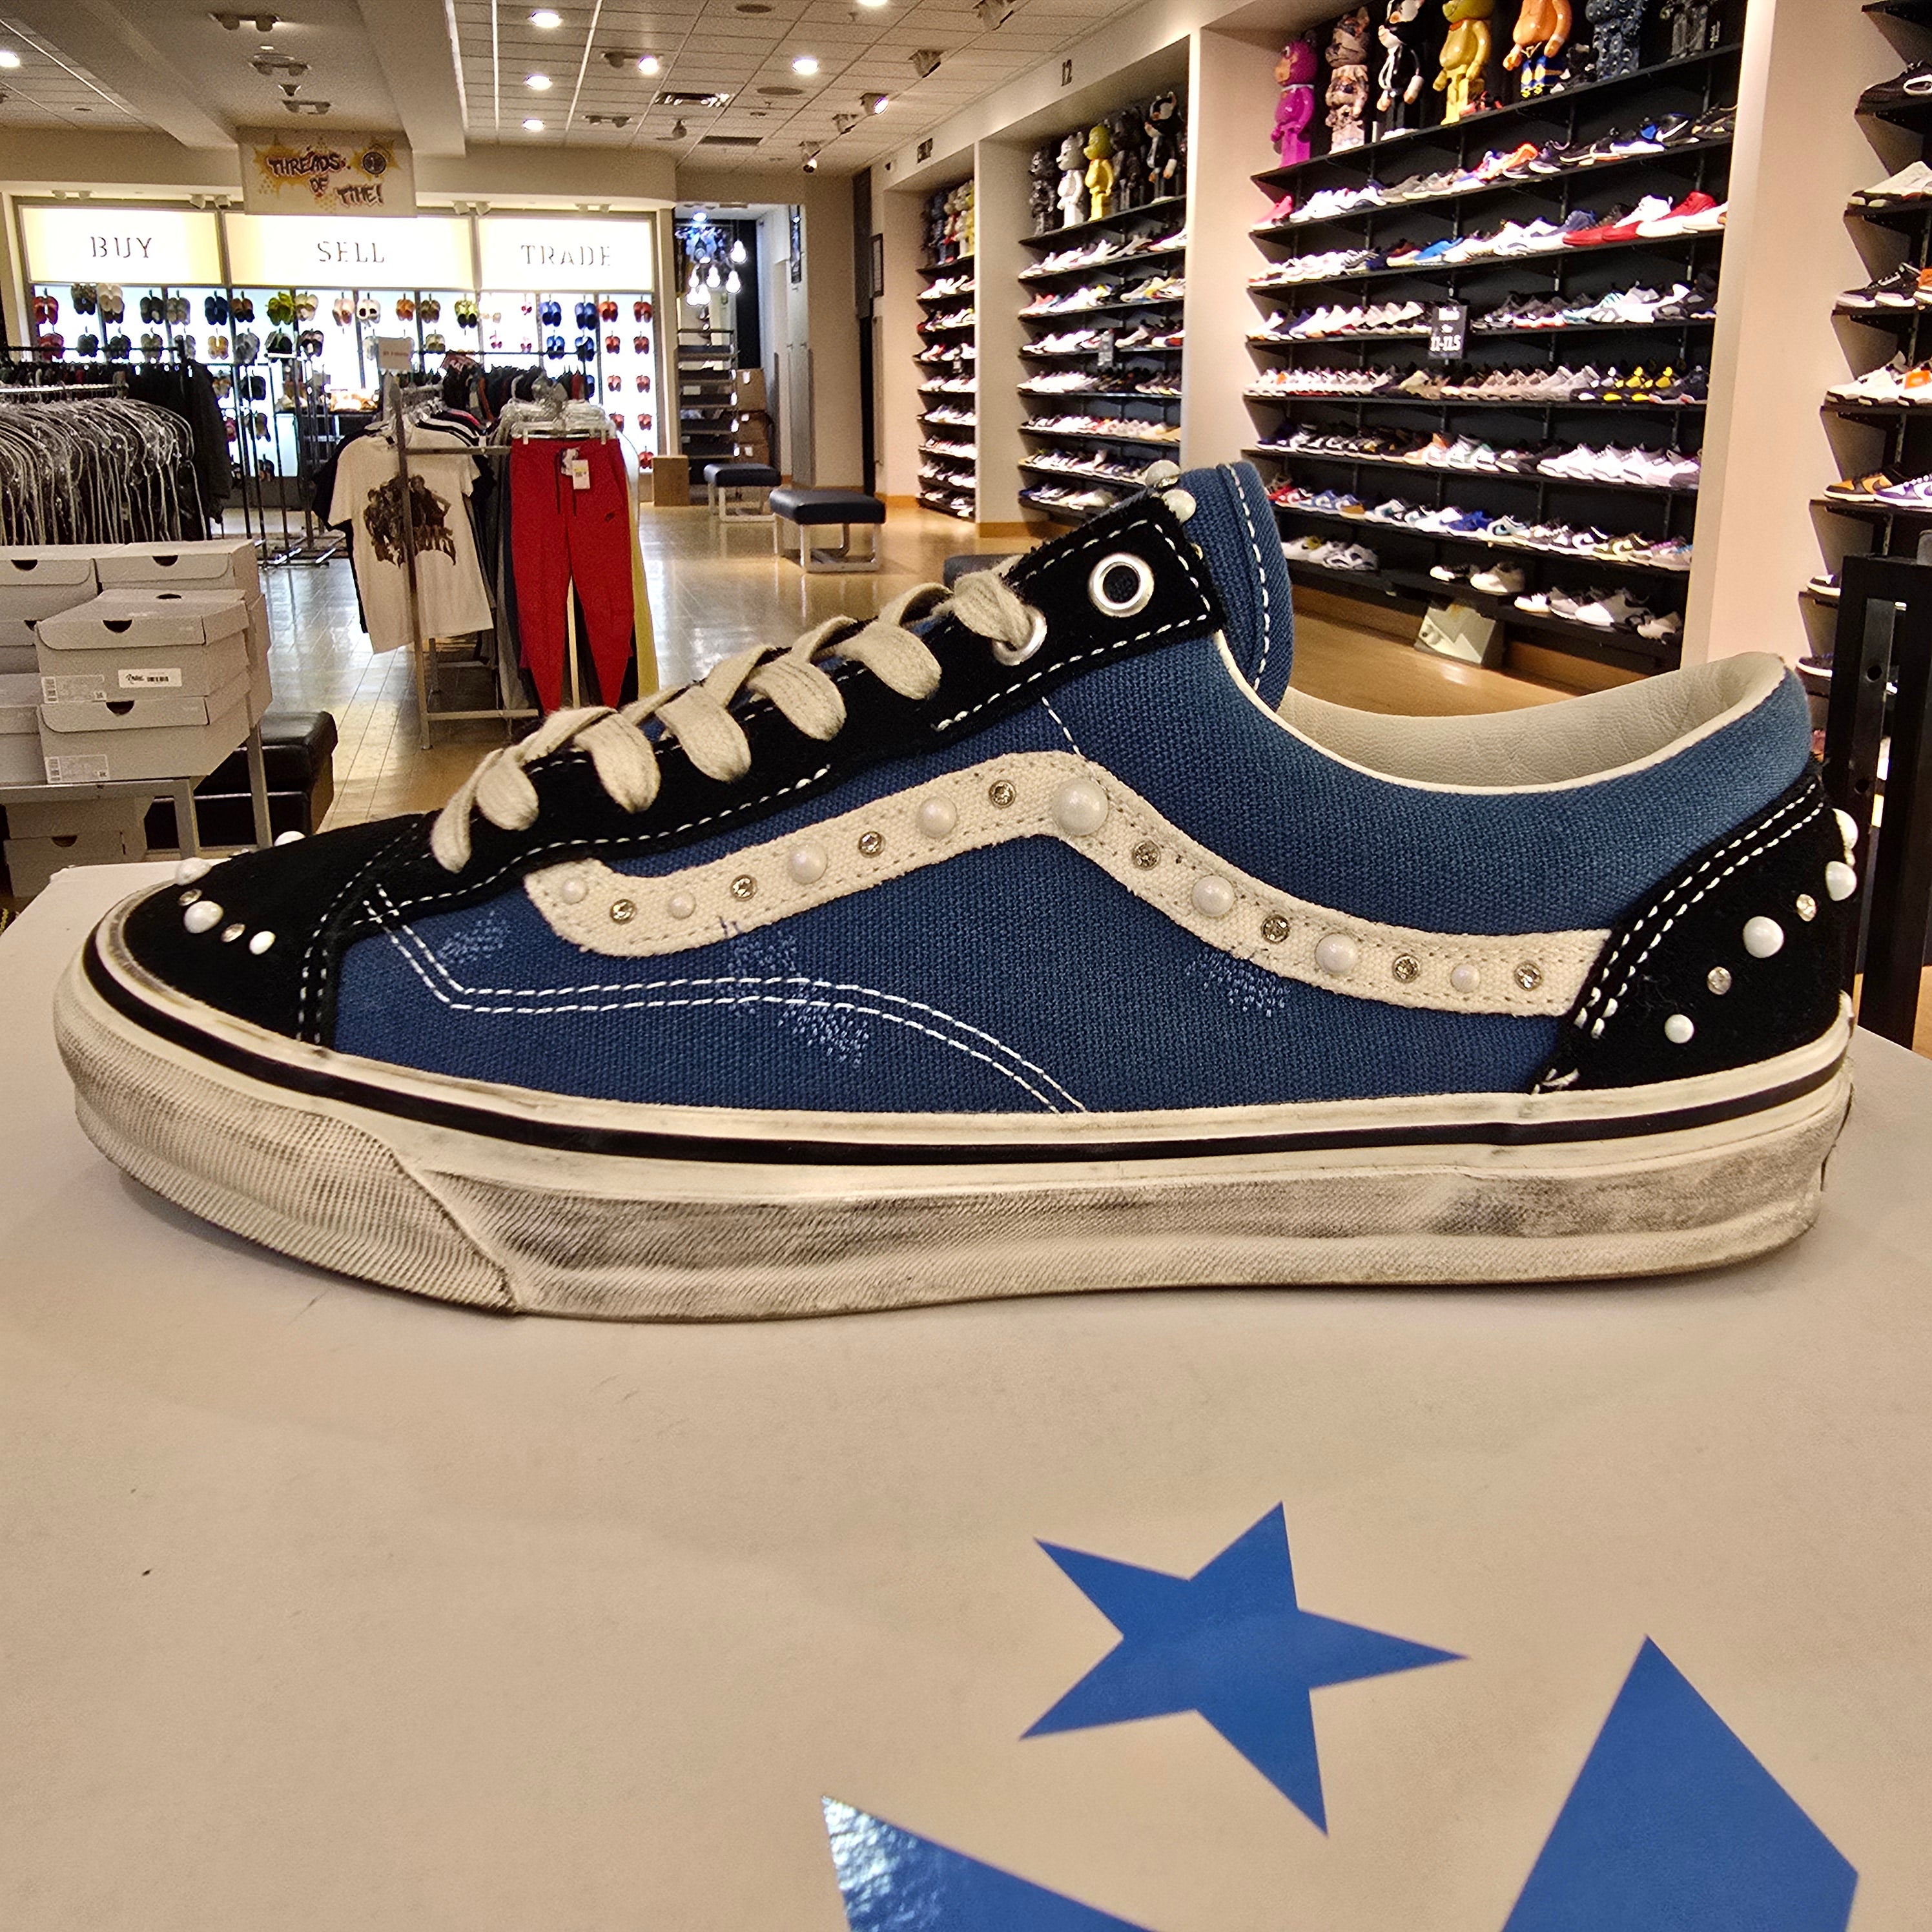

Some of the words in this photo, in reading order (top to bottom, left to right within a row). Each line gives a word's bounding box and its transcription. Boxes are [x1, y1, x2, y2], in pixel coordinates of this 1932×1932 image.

[267, 152, 342, 176] THREADS
[90, 236, 152, 258] BUY
[318, 241, 384, 262] SELL
[520, 245, 610, 266] TRADE
